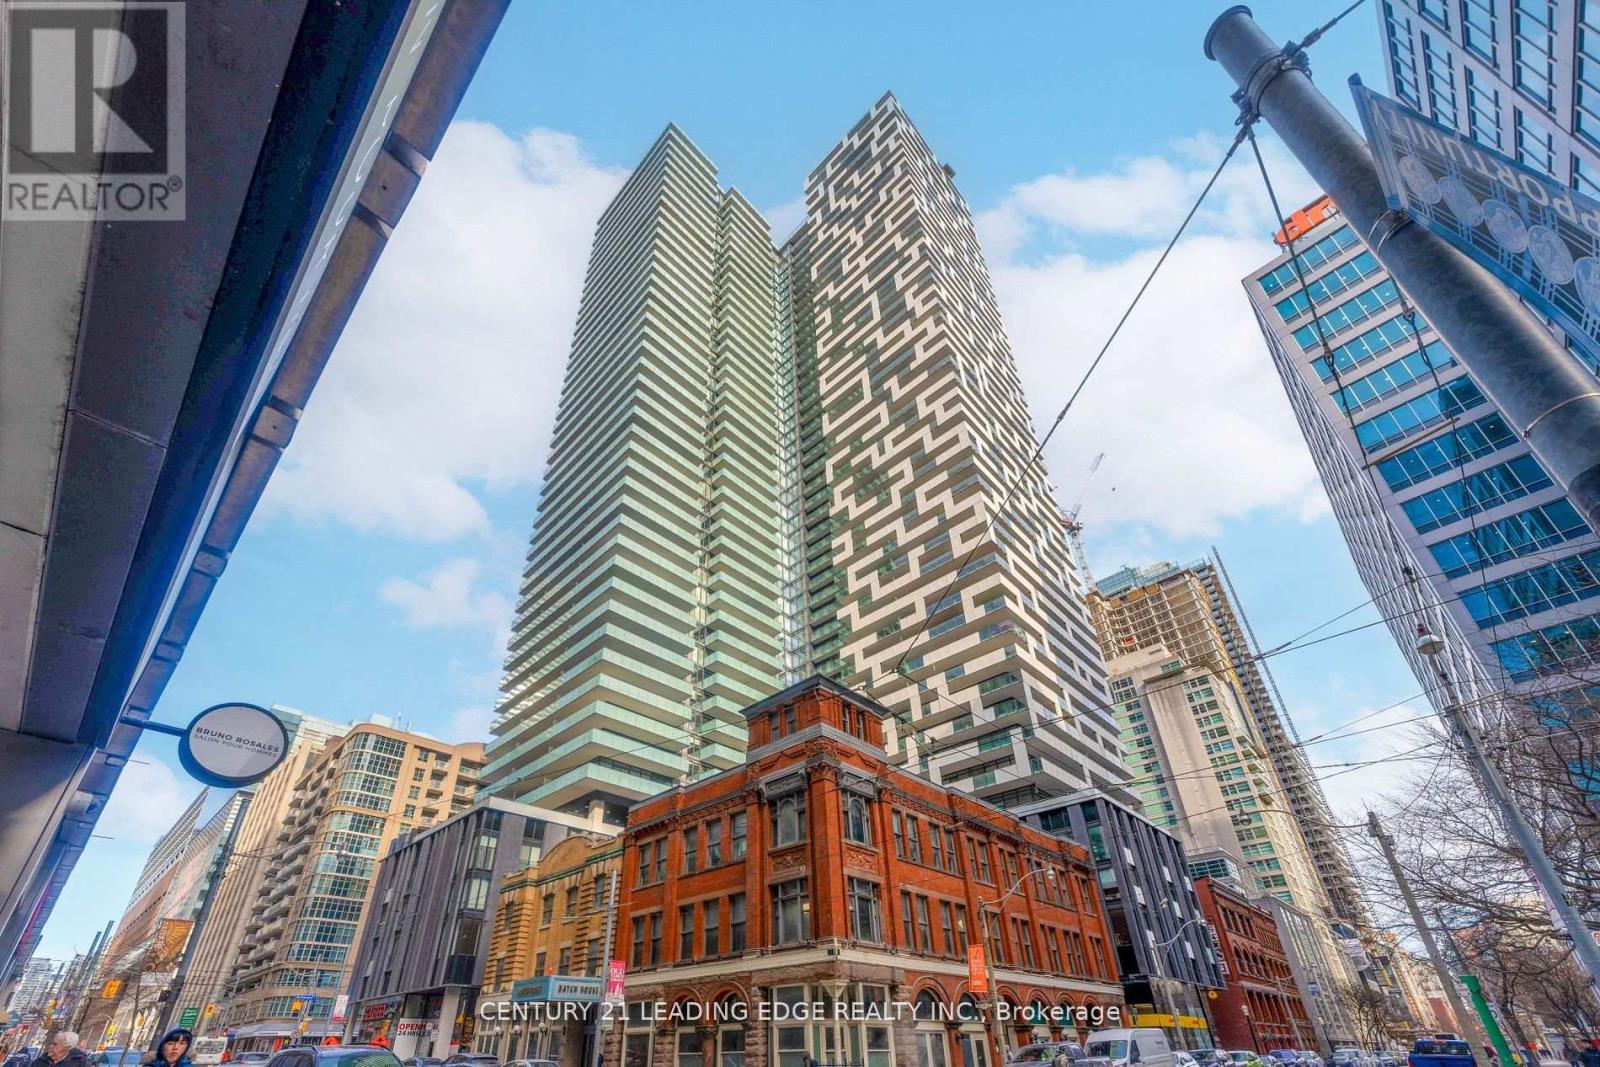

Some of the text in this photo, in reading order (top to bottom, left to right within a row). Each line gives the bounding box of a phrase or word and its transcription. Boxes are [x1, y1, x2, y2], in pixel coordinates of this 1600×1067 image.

[194, 733, 277, 757] SALON POUR HOMMES
[196, 726, 280, 753] BRUNO ROSALES
